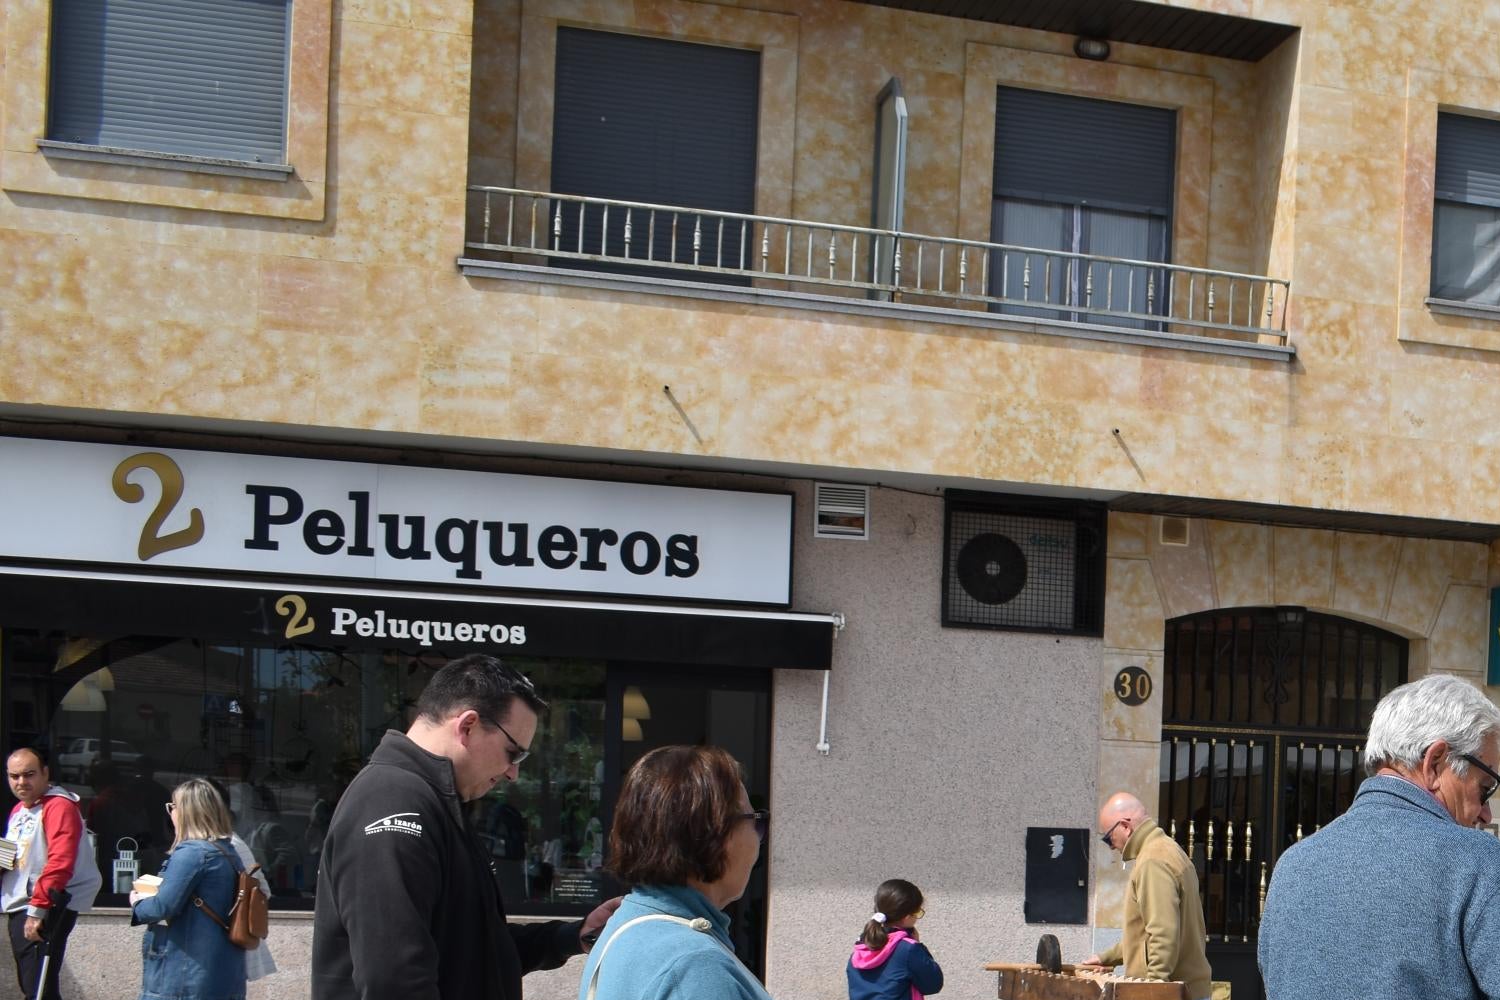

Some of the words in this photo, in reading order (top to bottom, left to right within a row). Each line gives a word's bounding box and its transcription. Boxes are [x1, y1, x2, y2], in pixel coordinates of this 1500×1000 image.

[111, 451, 206, 562] 2
[243, 484, 701, 580] Peluqueros
[275, 594, 316, 640] 2
[330, 607, 527, 647] Peluqueros
[1118, 672, 1151, 700] 30
